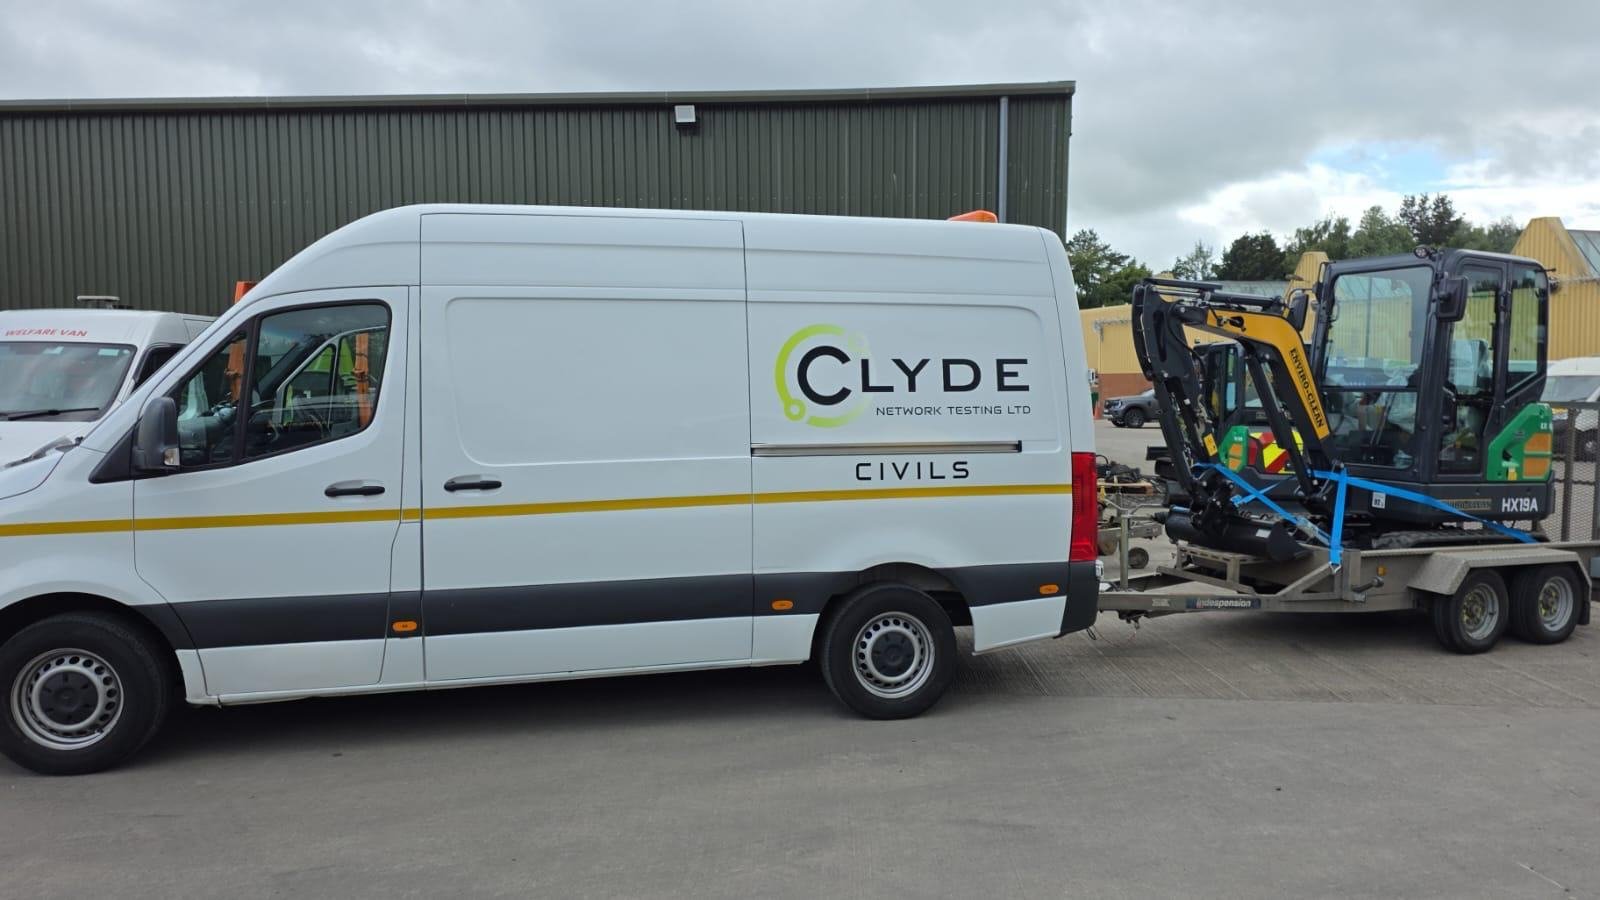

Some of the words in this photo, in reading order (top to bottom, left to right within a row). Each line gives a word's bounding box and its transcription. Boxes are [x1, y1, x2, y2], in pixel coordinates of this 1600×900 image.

[60, 329, 88, 337] VAN
[797, 345, 1030, 406] CLYDE
[1289, 347, 1324, 428] ENVIRO-CLEAN
[876, 406, 942, 416] NETWORK
[947, 405, 1002, 415] TESTING
[1007, 405, 1031, 415] LTD
[855, 461, 970, 481] CIVILS
[1501, 497, 1539, 513] HX19A
